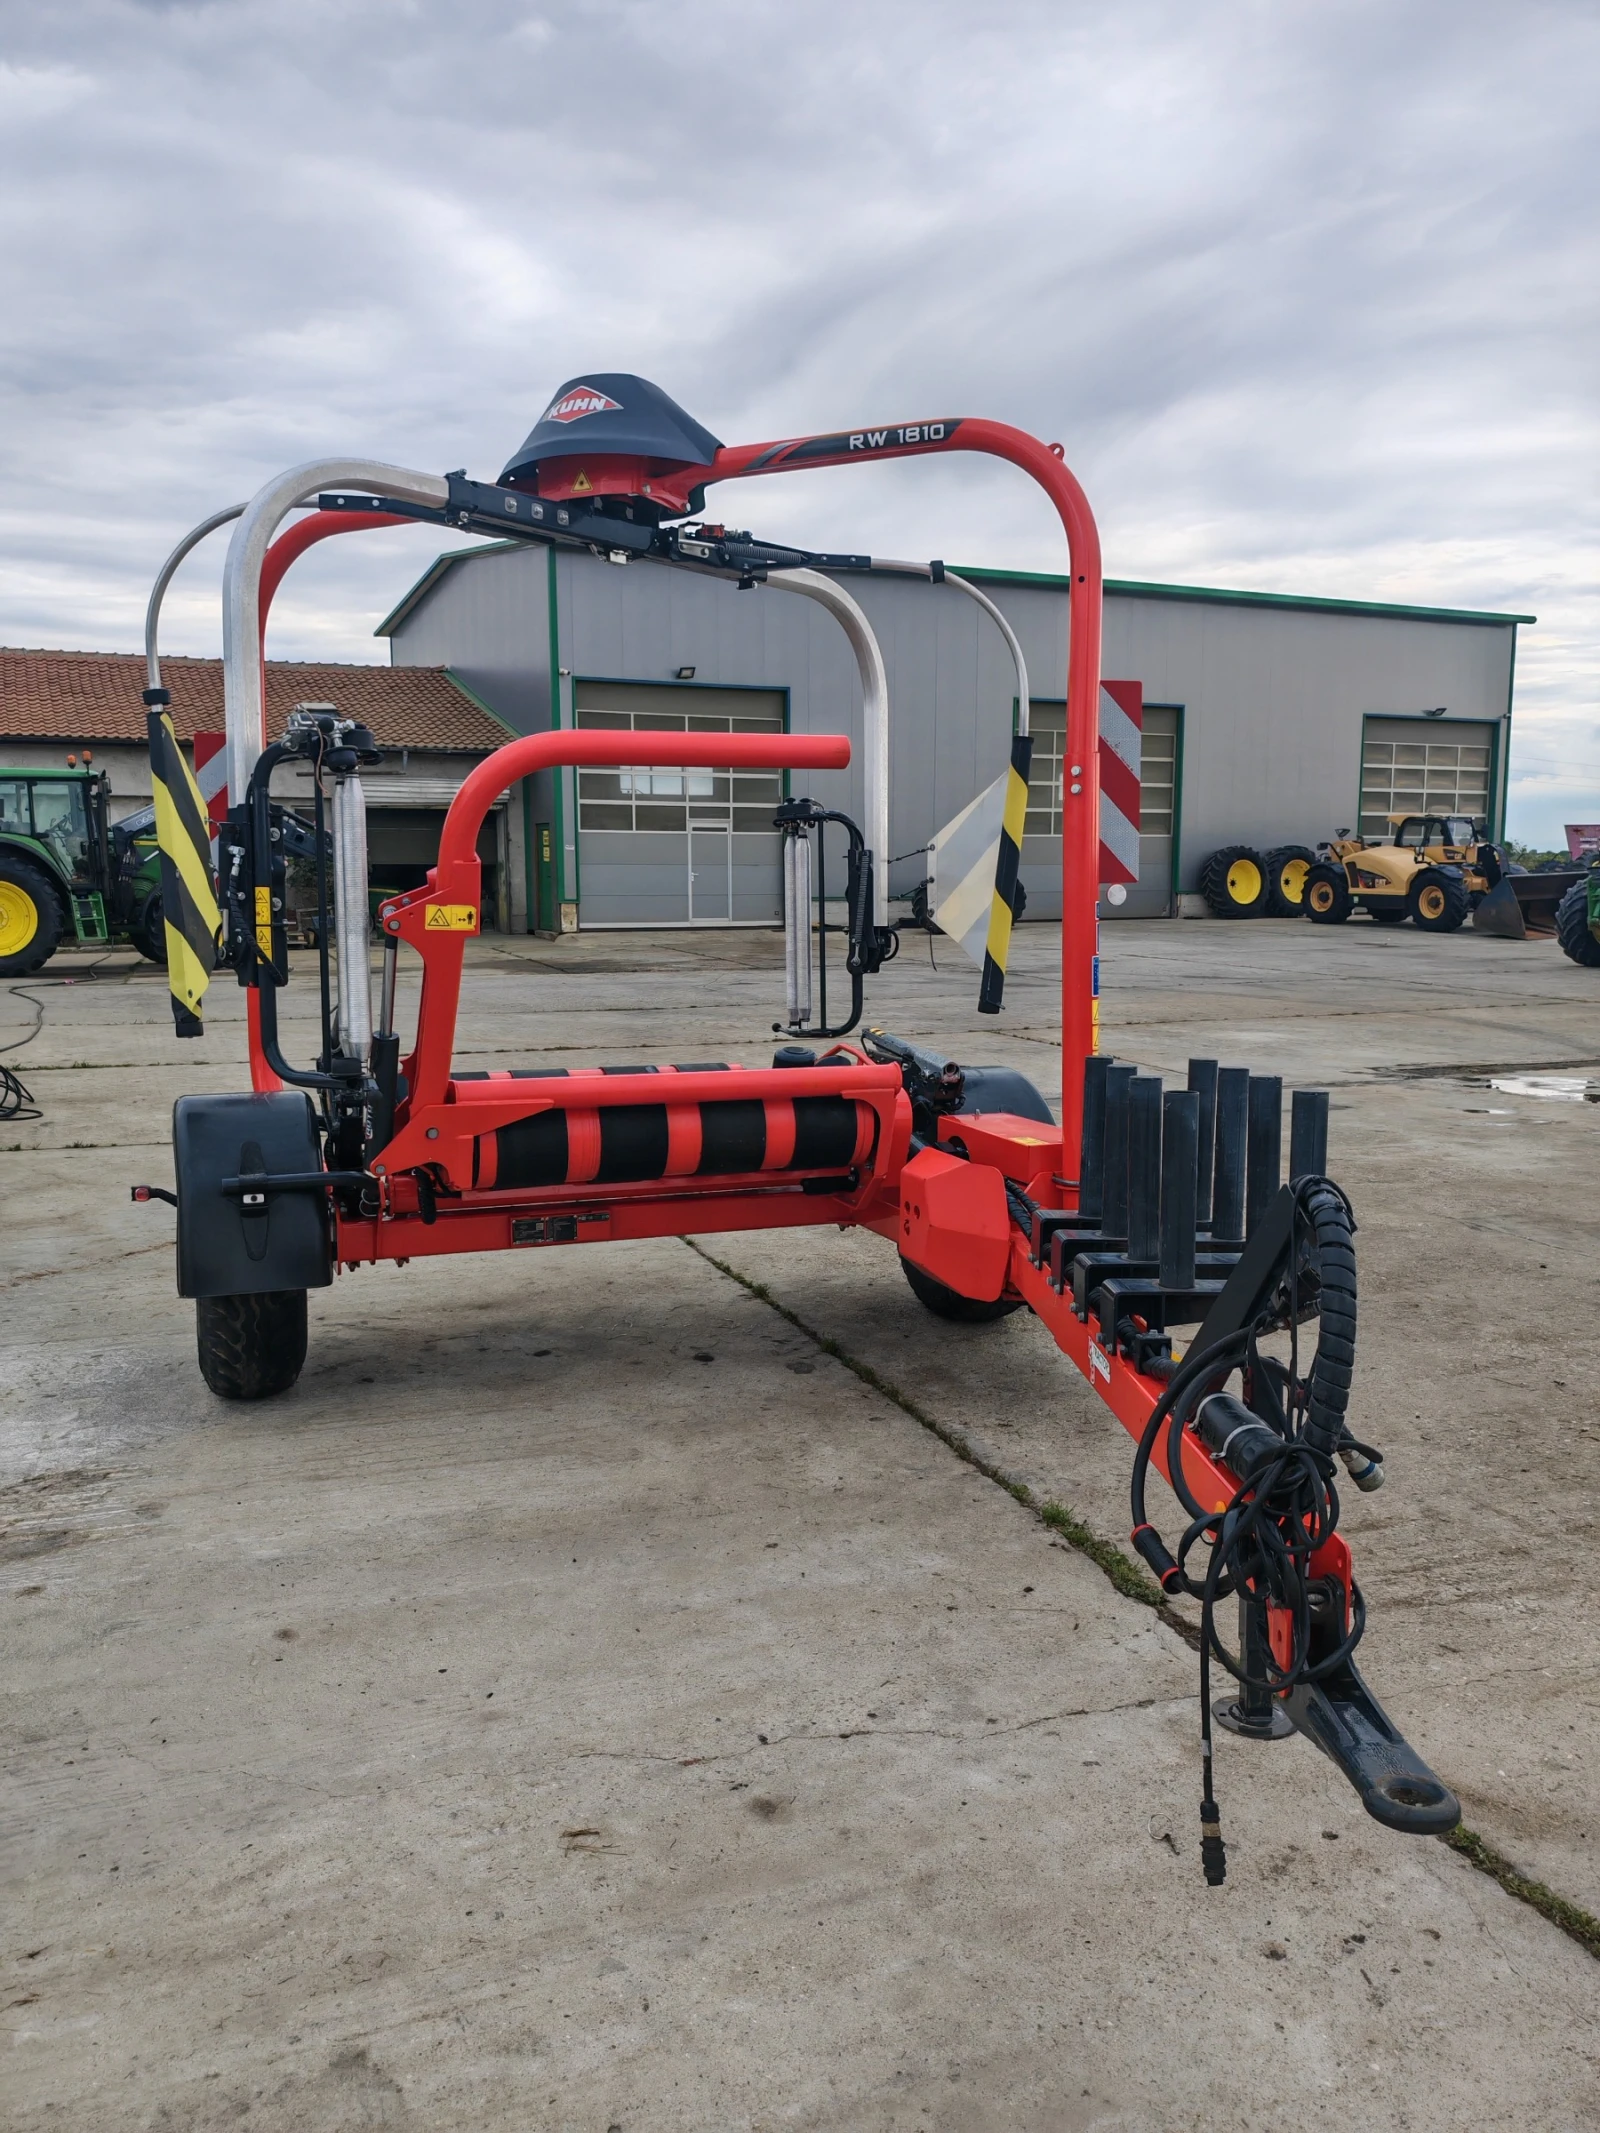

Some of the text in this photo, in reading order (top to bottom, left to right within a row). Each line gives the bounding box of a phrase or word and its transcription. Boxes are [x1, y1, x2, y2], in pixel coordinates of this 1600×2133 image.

[548, 398, 606, 419] KUHN
[849, 424, 945, 450] RW 1810
[1375, 879, 1387, 887] CAT
